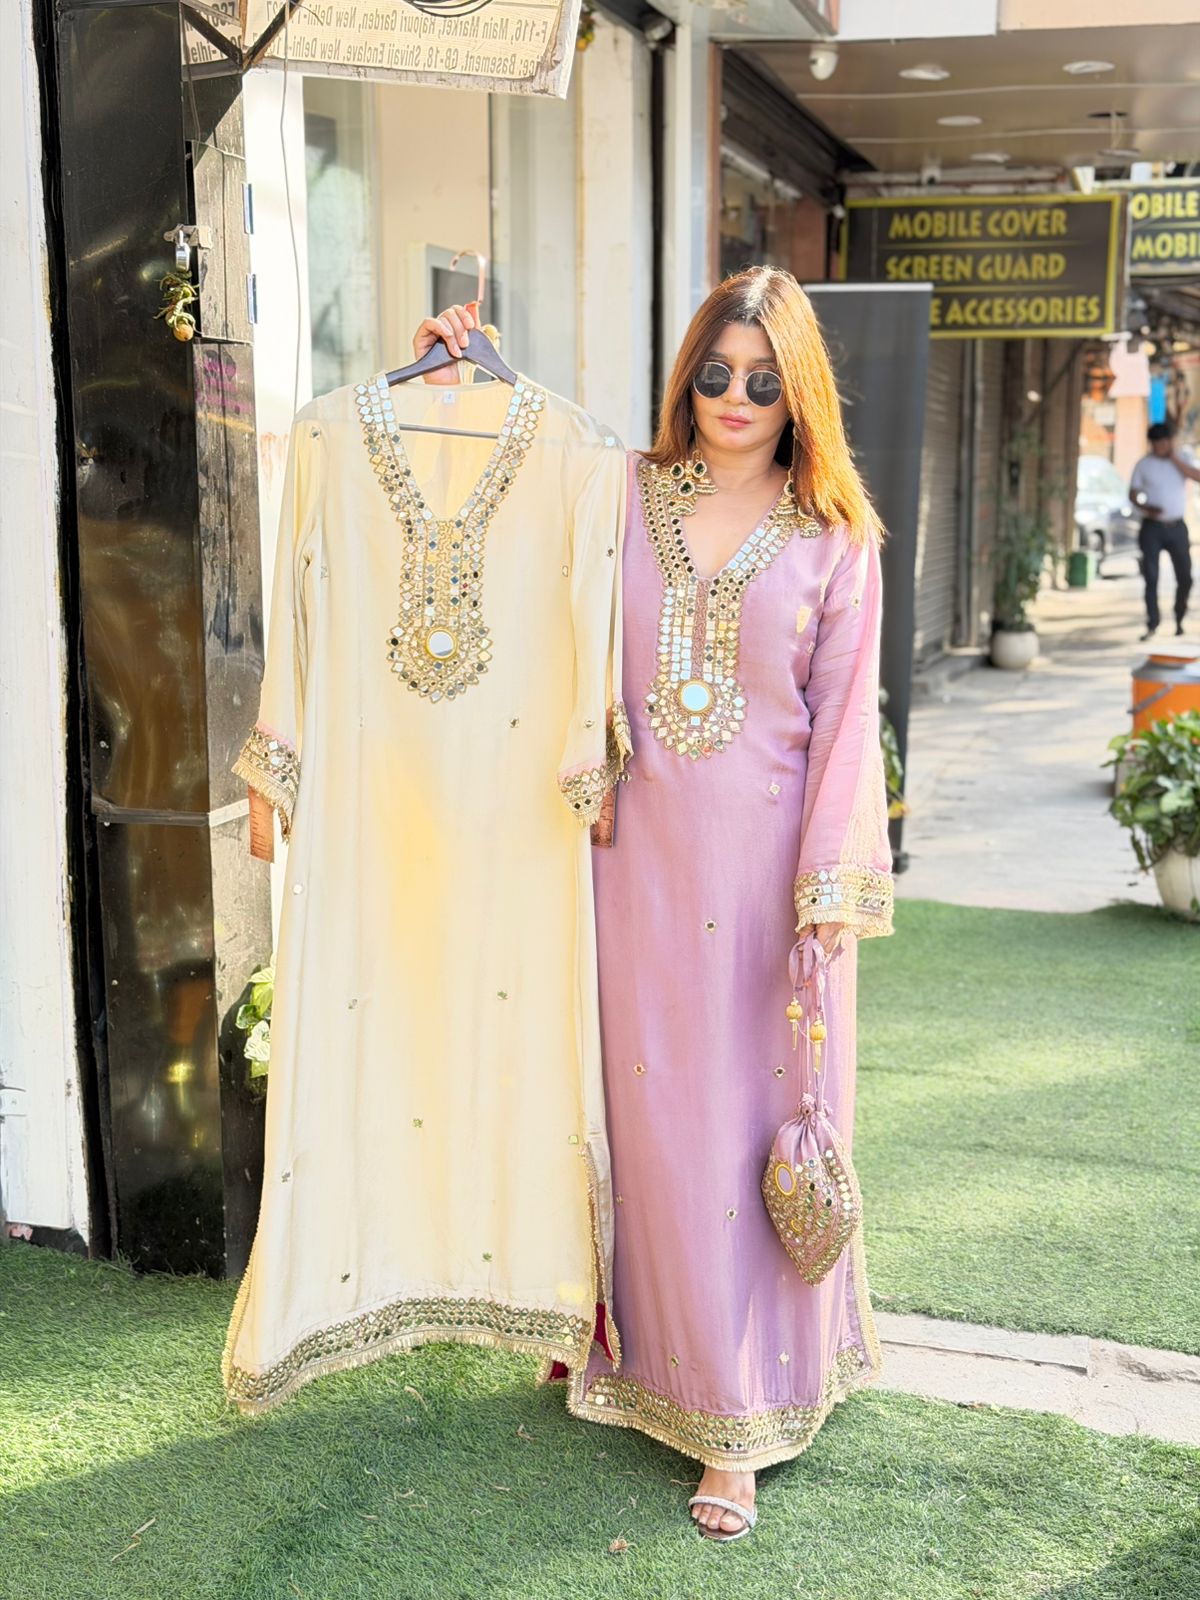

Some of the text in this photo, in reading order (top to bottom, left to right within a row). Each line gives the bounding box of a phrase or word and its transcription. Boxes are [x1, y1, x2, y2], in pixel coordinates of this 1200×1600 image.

[1131, 190, 1199, 220] OBILE
[888, 208, 1068, 239] MOBILE COVER
[1131, 231, 1200, 259] MOBI
[885, 252, 1067, 281] SCREEN GUARD
[945, 295, 1100, 325] ACCESSORIES
